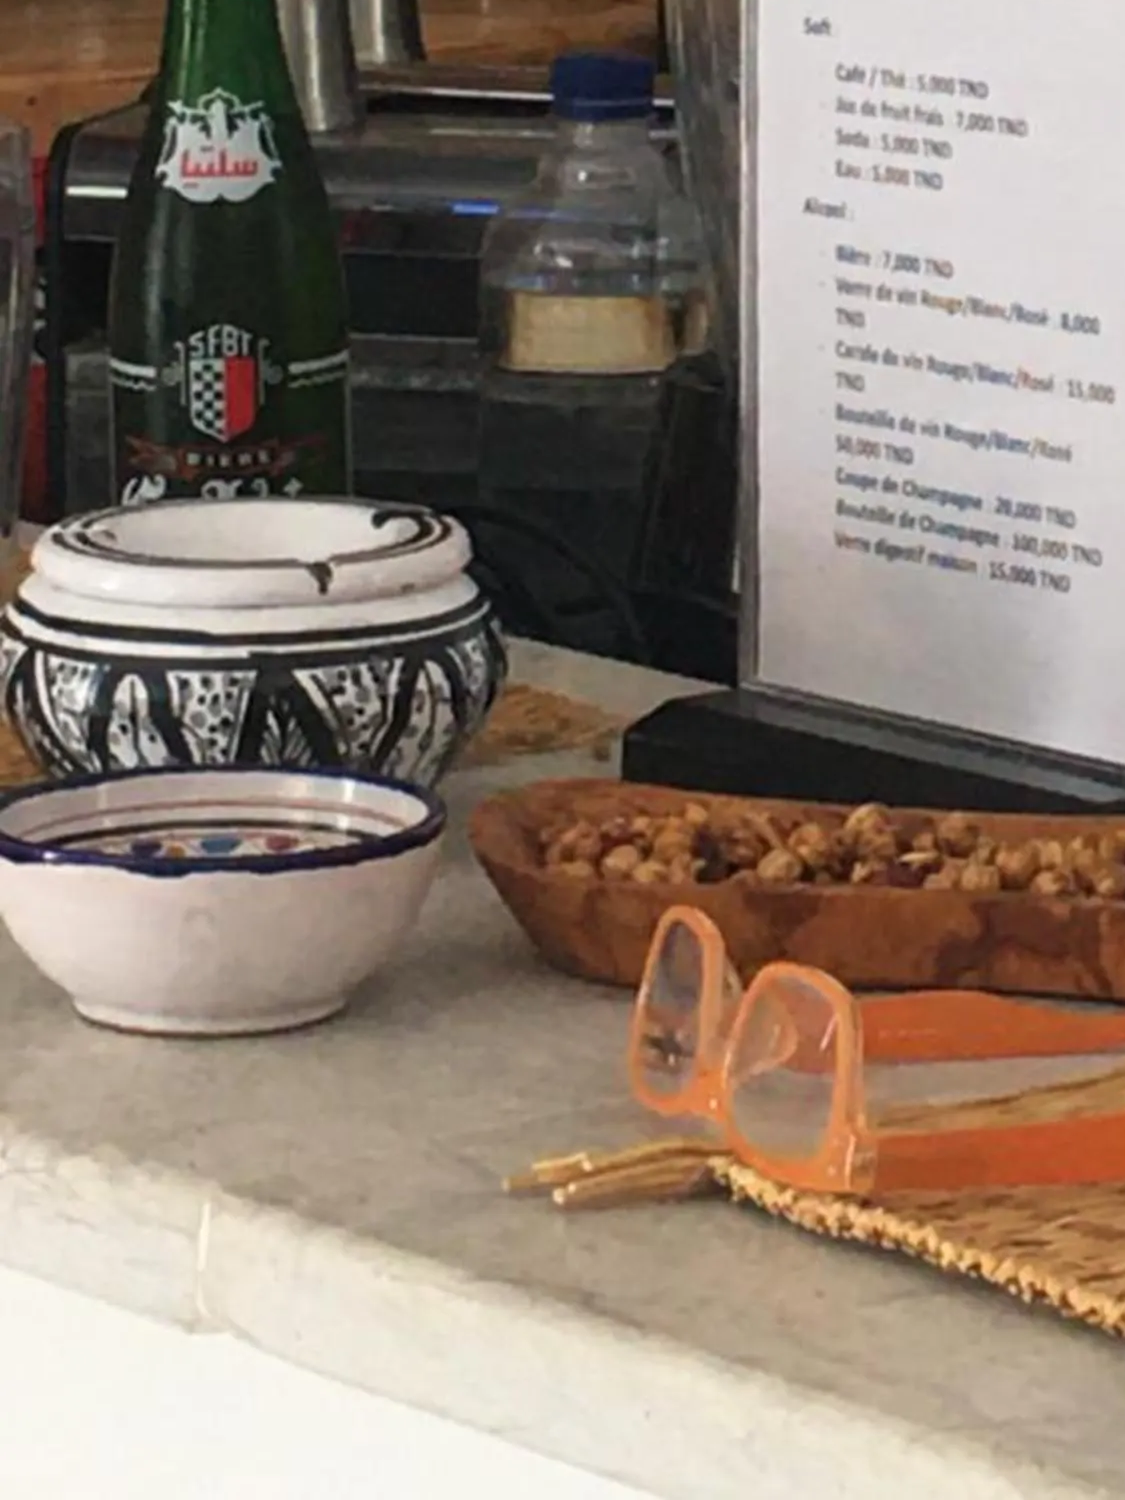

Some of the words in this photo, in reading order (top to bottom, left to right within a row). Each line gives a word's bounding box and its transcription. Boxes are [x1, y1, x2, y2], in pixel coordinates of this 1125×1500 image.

[959, 78, 990, 100] TND
[998, 117, 1029, 138] TND
[922, 138, 953, 159] TND
[913, 170, 943, 191] TND
[924, 258, 954, 280] TND
[836, 307, 866, 328] TND
[188, 324, 254, 358] SFBT
[836, 371, 866, 392] TND
[884, 443, 914, 466] TND
[1046, 506, 1077, 530] TND
[1072, 545, 1103, 568] TND
[1040, 570, 1071, 594] TND
